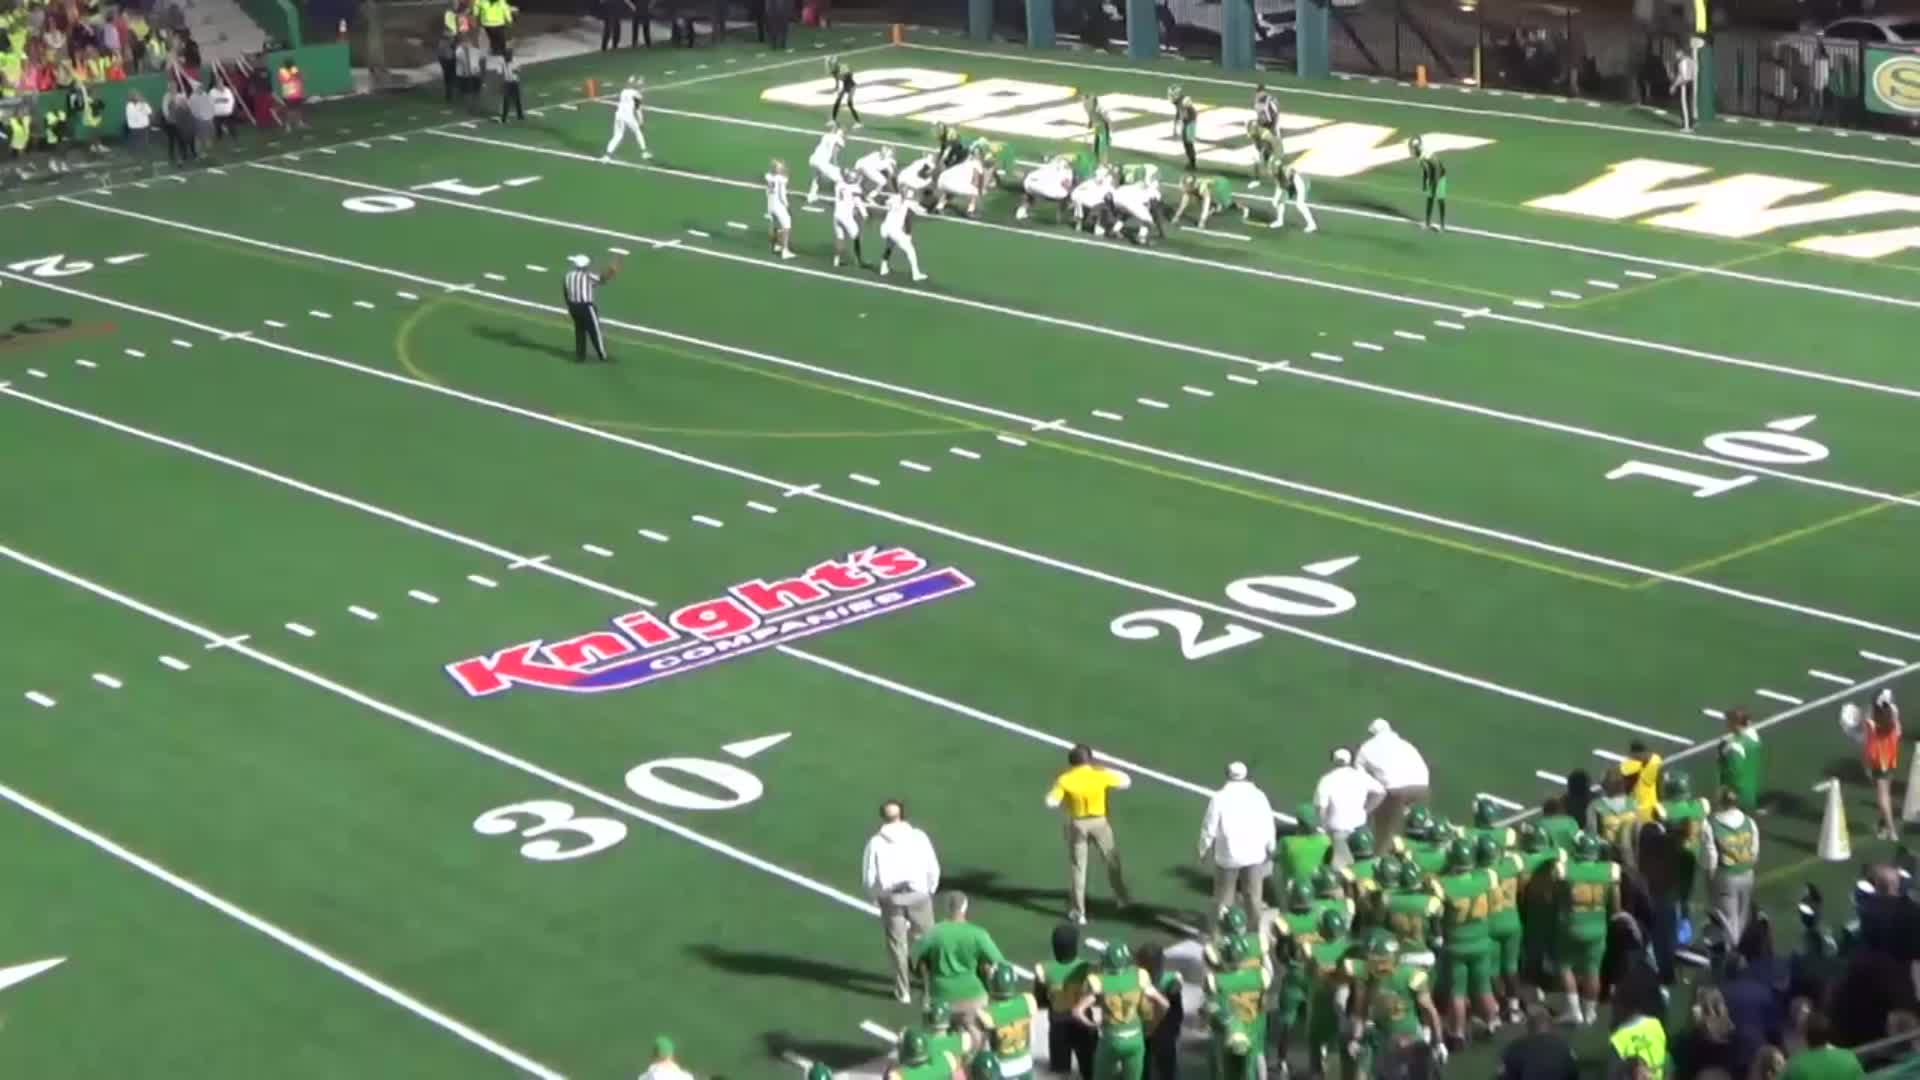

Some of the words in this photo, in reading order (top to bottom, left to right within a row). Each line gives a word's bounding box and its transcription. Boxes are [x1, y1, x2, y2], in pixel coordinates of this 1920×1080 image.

[342, 176, 500, 213] 10
[761, 67, 1497, 177] GREEN
[1521, 157, 1920, 258] W
[1605, 431, 1829, 498] 10
[445, 545, 927, 697] Knight's
[650, 591, 904, 671] COMPANIES
[1110, 575, 1357, 660] 20
[473, 757, 763, 861] 30
